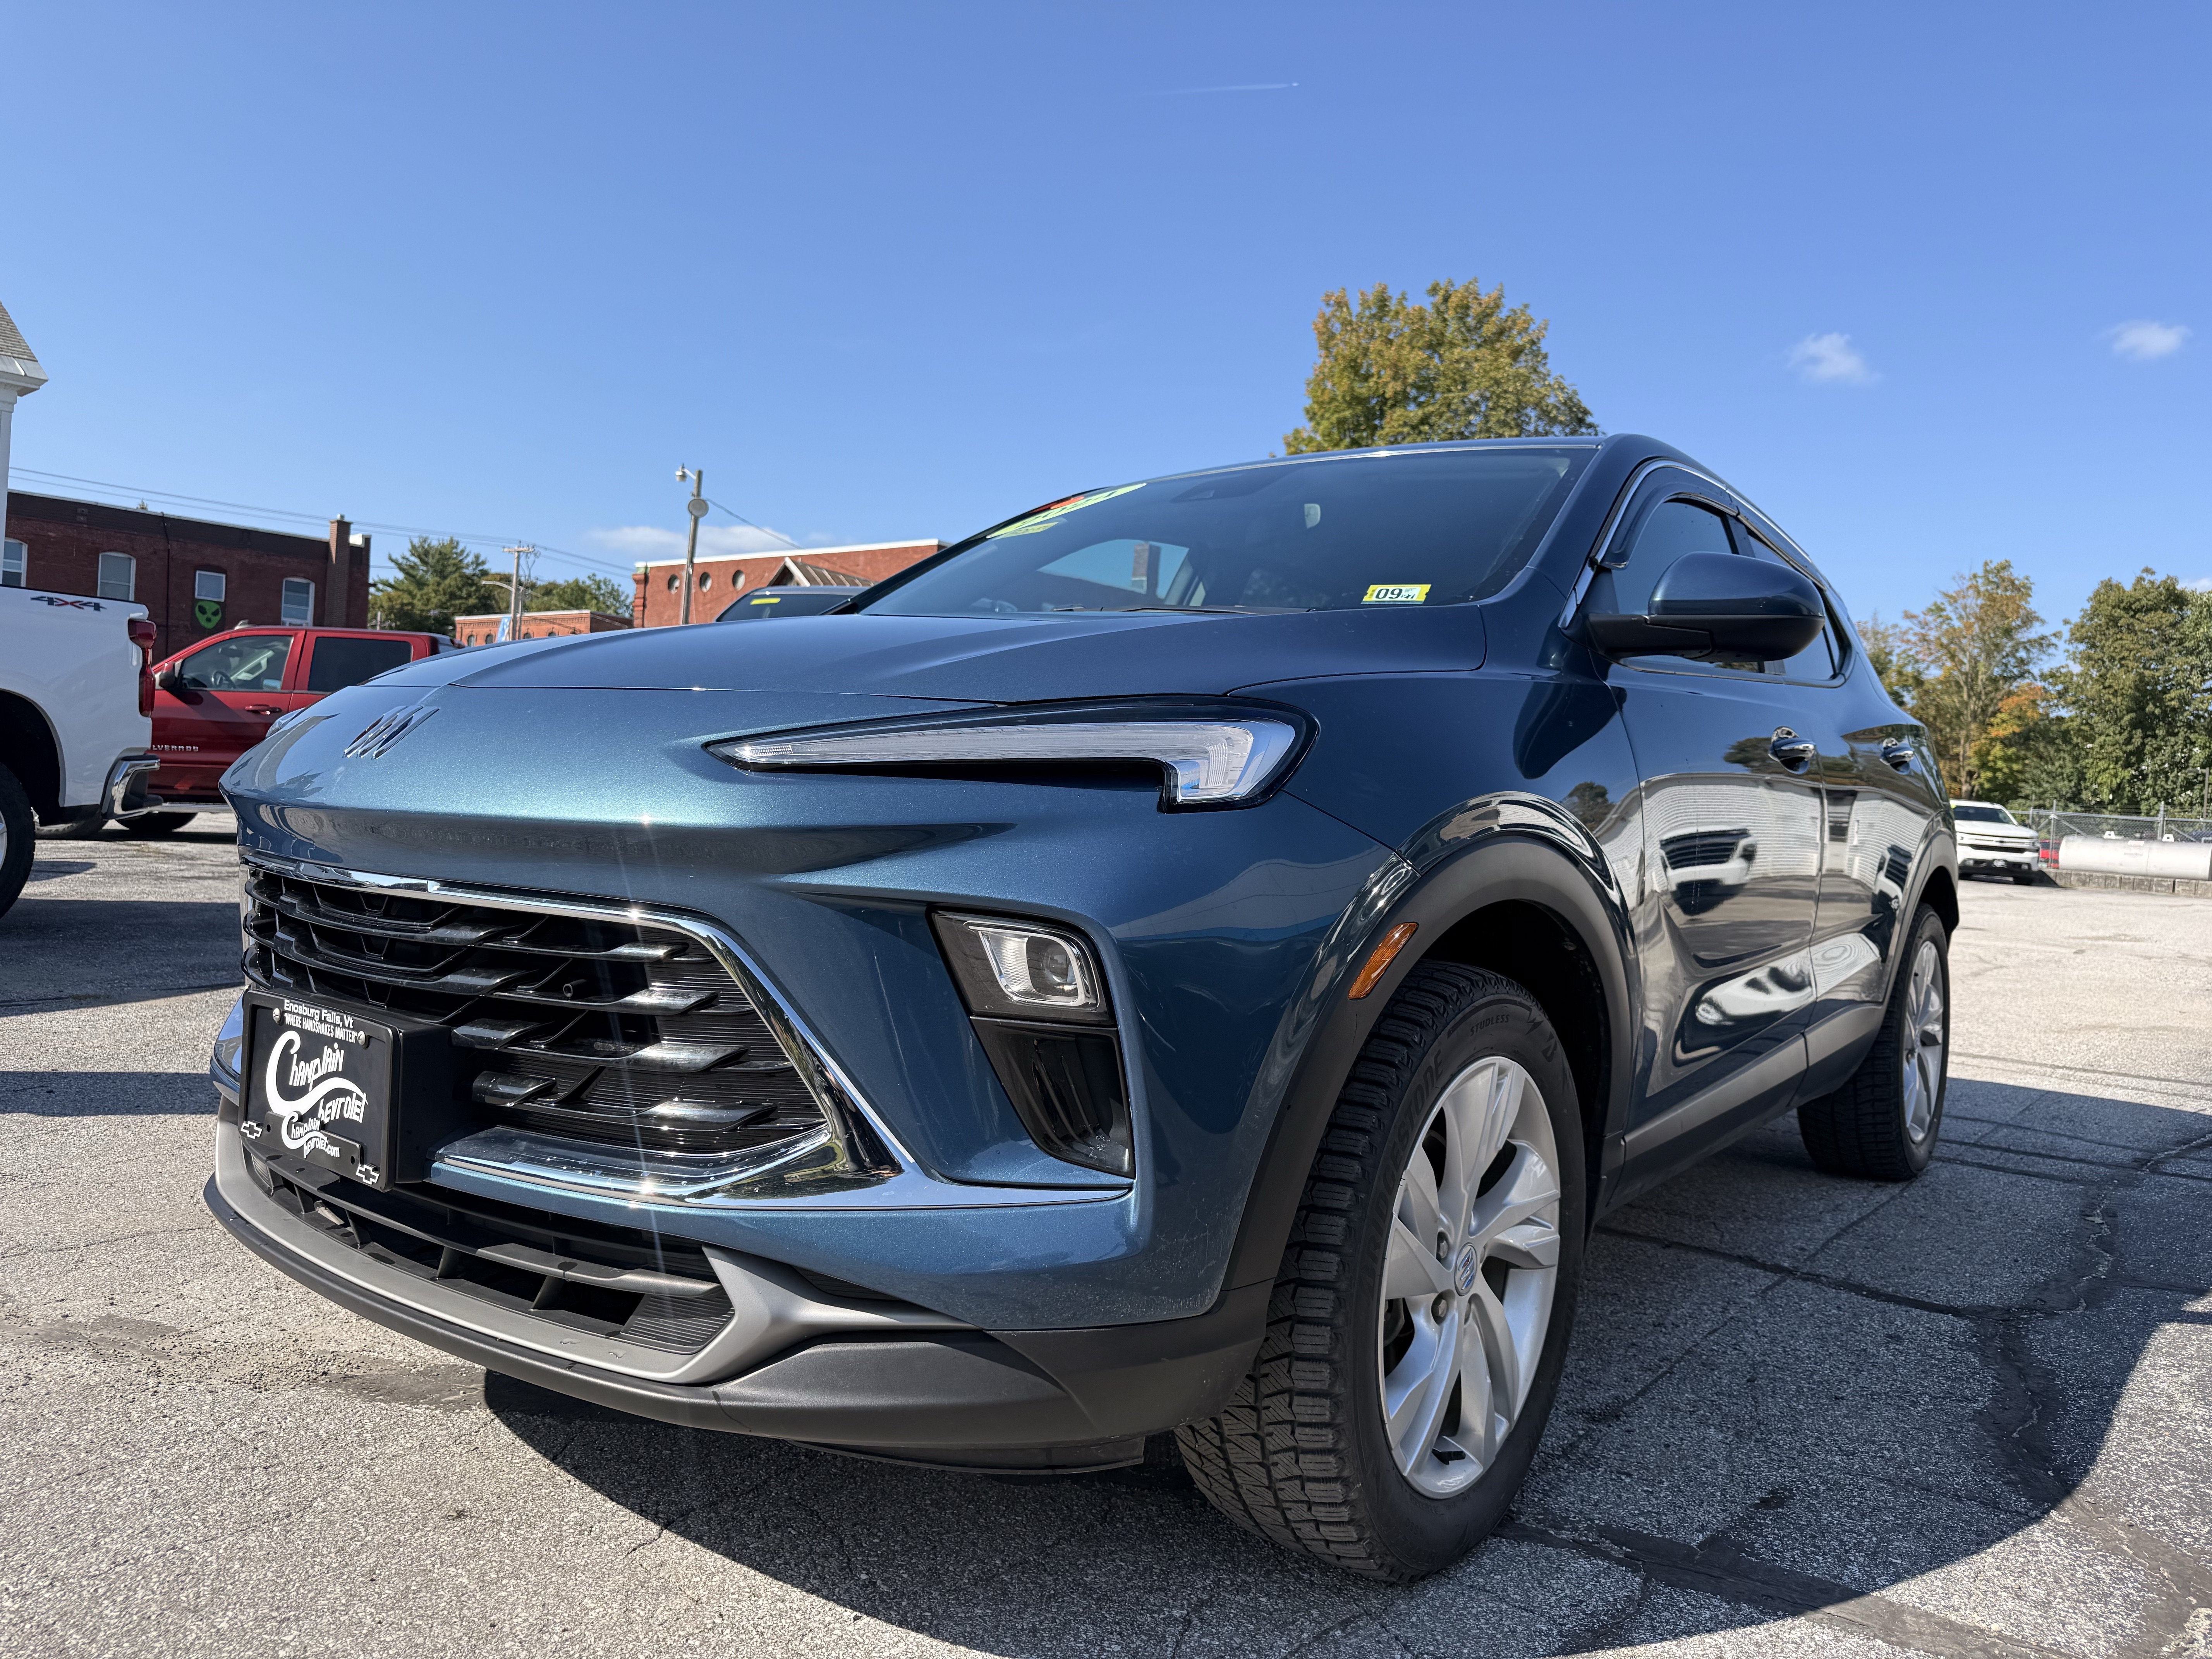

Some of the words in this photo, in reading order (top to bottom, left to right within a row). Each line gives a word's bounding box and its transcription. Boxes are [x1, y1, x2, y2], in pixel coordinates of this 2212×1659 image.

[1375, 588, 1403, 599] 09
[284, 999, 320, 1021] Enosburg
[322, 1009, 343, 1027] Falls,
[344, 1015, 354, 1029] Vt
[1470, 1014, 1510, 1037] STUDLESS
[302, 1017, 334, 1037] HANDSHAKES
[1360, 1048, 1443, 1301] BRIDGESTONE
